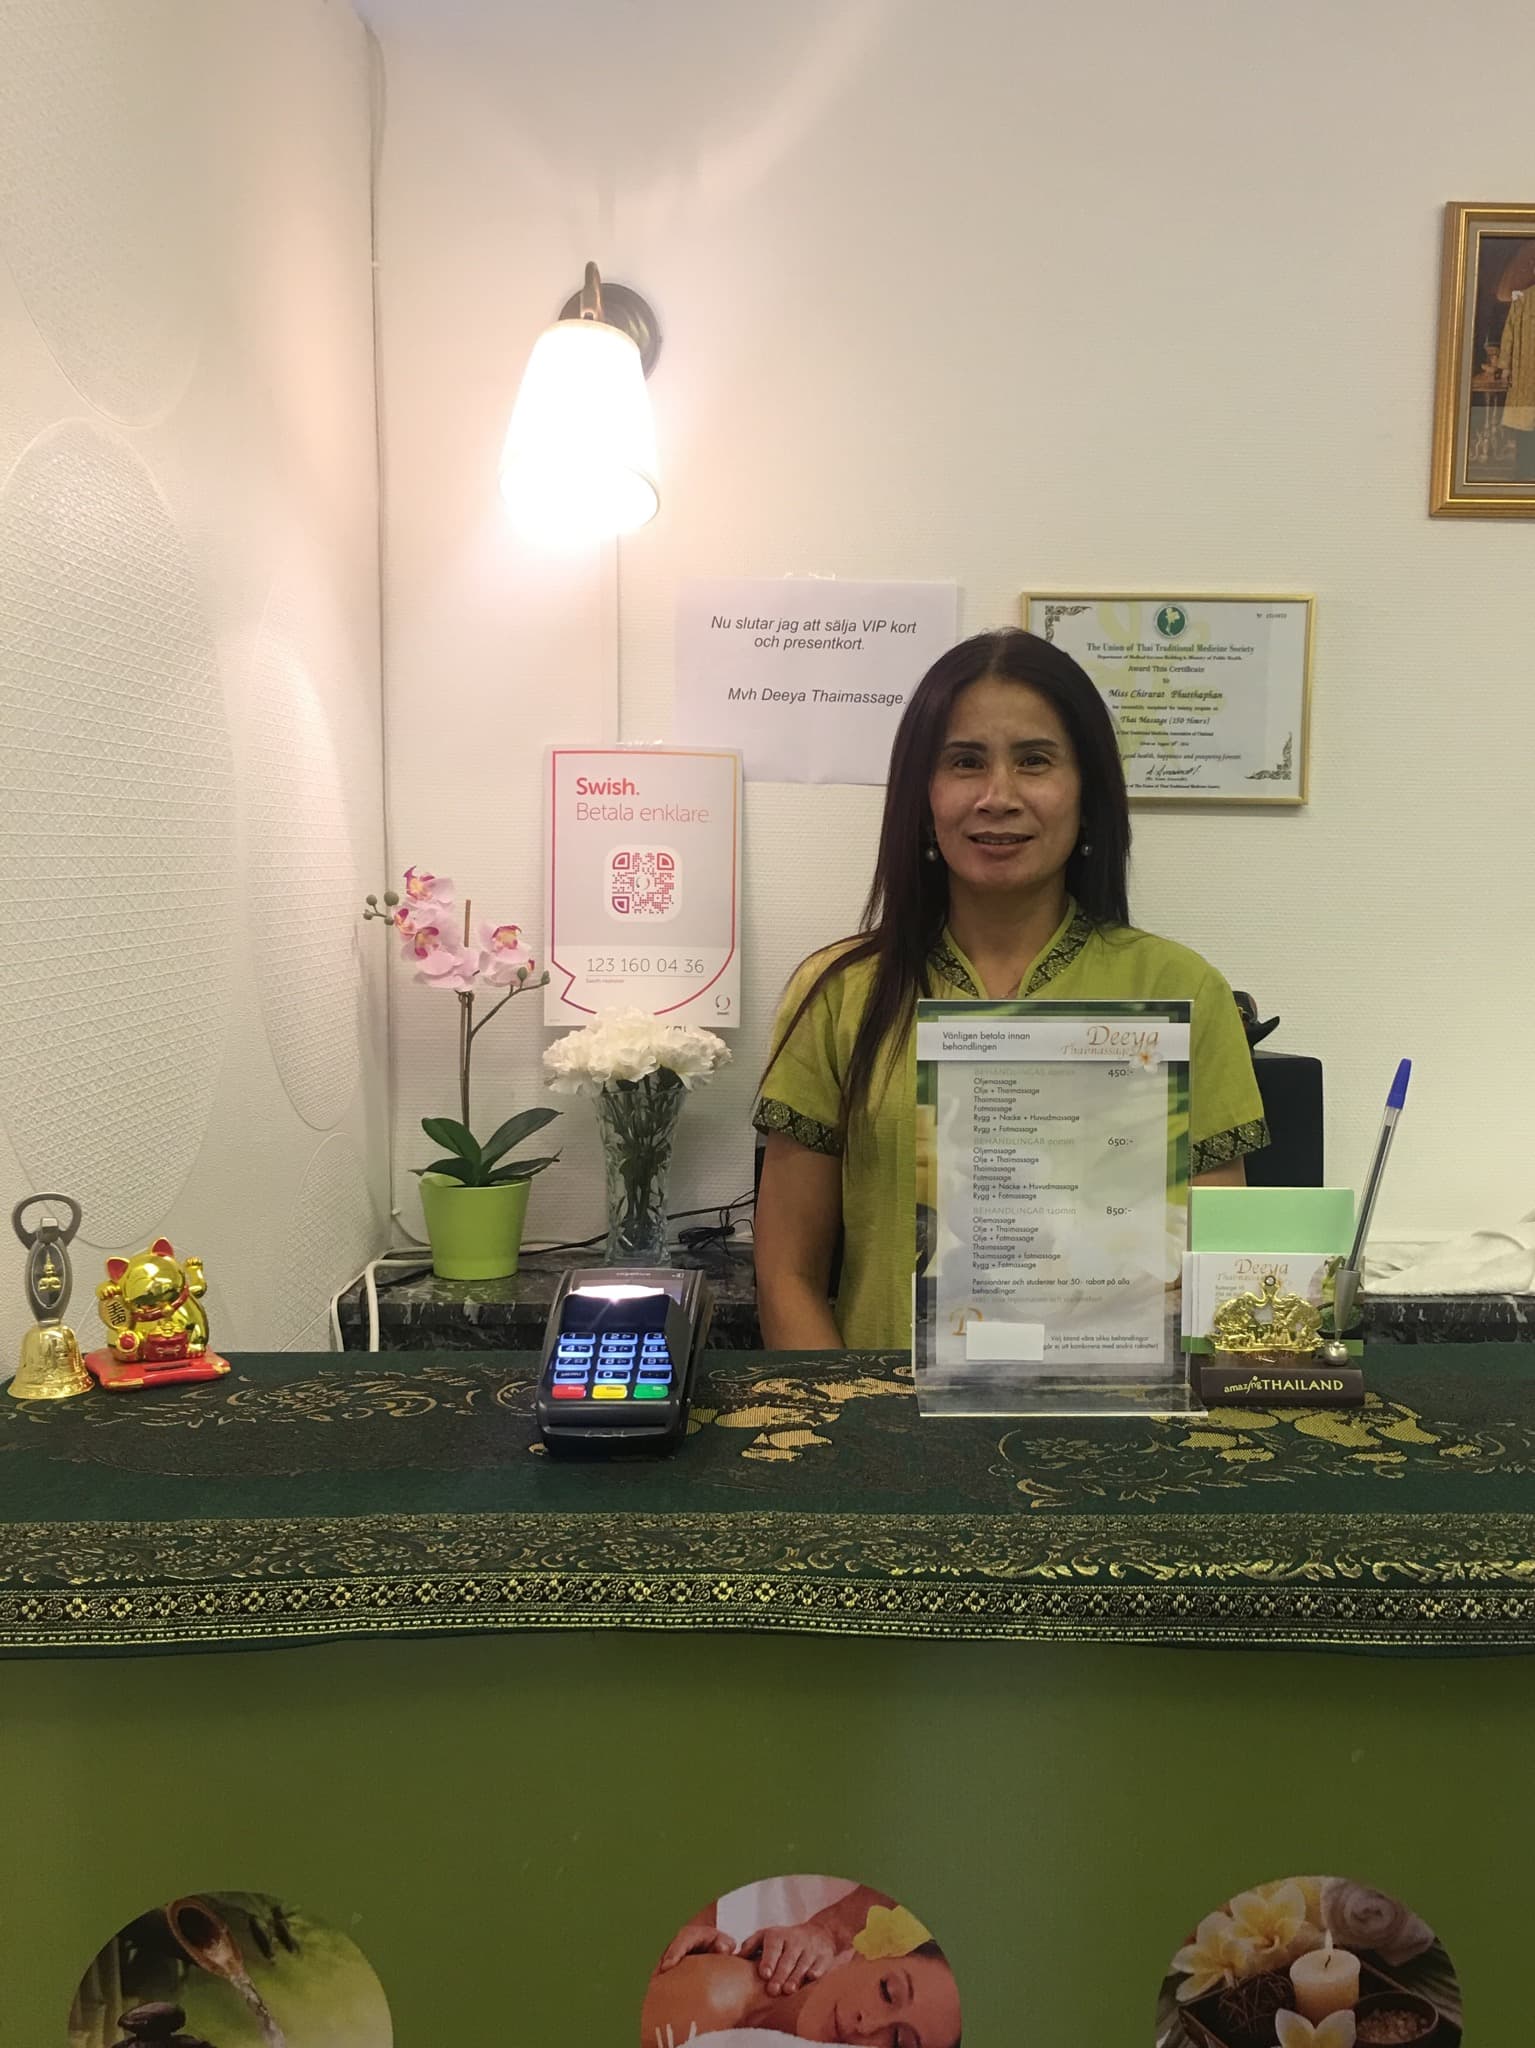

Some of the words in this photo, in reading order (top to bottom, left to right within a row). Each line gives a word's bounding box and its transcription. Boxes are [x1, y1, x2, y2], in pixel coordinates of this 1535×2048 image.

[711, 616, 731, 629] Nu
[735, 616, 775, 630] slutar
[777, 618, 799, 633] jag
[803, 619, 821, 632] att
[824, 619, 857, 634] sälja
[861, 620, 887, 633] VIP
[890, 620, 917, 634] kort
[754, 636, 780, 648] och
[783, 636, 865, 651] presentkort.
[1103, 643, 1124, 652] Union
[1126, 643, 1135, 652] of
[1155, 643, 1194, 652] Traditional
[1197, 644, 1228, 653] Medicine
[1169, 665, 1205, 674] Certificate
[728, 688, 757, 701] Mvh
[761, 688, 806, 704] Deeya
[1108, 689, 1130, 698] Miss
[576, 777, 640, 796] Swish.
[576, 802, 634, 821] Betala
[587, 958, 615, 973] 123
[620, 958, 651, 973] 160
[657, 959, 678, 973] 04
[684, 959, 704, 973] 36
[943, 1031, 978, 1042] Vänligen
[980, 1031, 1005, 1040] betala
[1008, 1032, 1031, 1040] innan
[1086, 1025, 1160, 1056] Deeya
[943, 1042, 997, 1053] behandlingen
[1108, 1069, 1134, 1078] 450:-
[999, 1113, 1021, 1122] Nacke
[1108, 1137, 1134, 1147] 650:-
[996, 1155, 1039, 1165] Thaimassage
[973, 1164, 1016, 1174] Thaimassage
[973, 1182, 989, 1192] Rygg
[998, 1182, 1020, 1190] Nacke
[1029, 1182, 1079, 1191] Huvudmassage
[973, 1191, 989, 1201] Rygg
[973, 1206, 1044, 1215] BEHANDLINGAR
[1106, 1206, 1132, 1216] 850:-
[996, 1224, 1039, 1234] Thaimassage
[973, 1242, 1015, 1252] Thaimassage
[973, 1260, 989, 1270] Rygg
[1057, 1278, 1069, 1286] har
[1106, 1278, 1116, 1288] på
[1261, 1379, 1344, 1392] THAILAND
